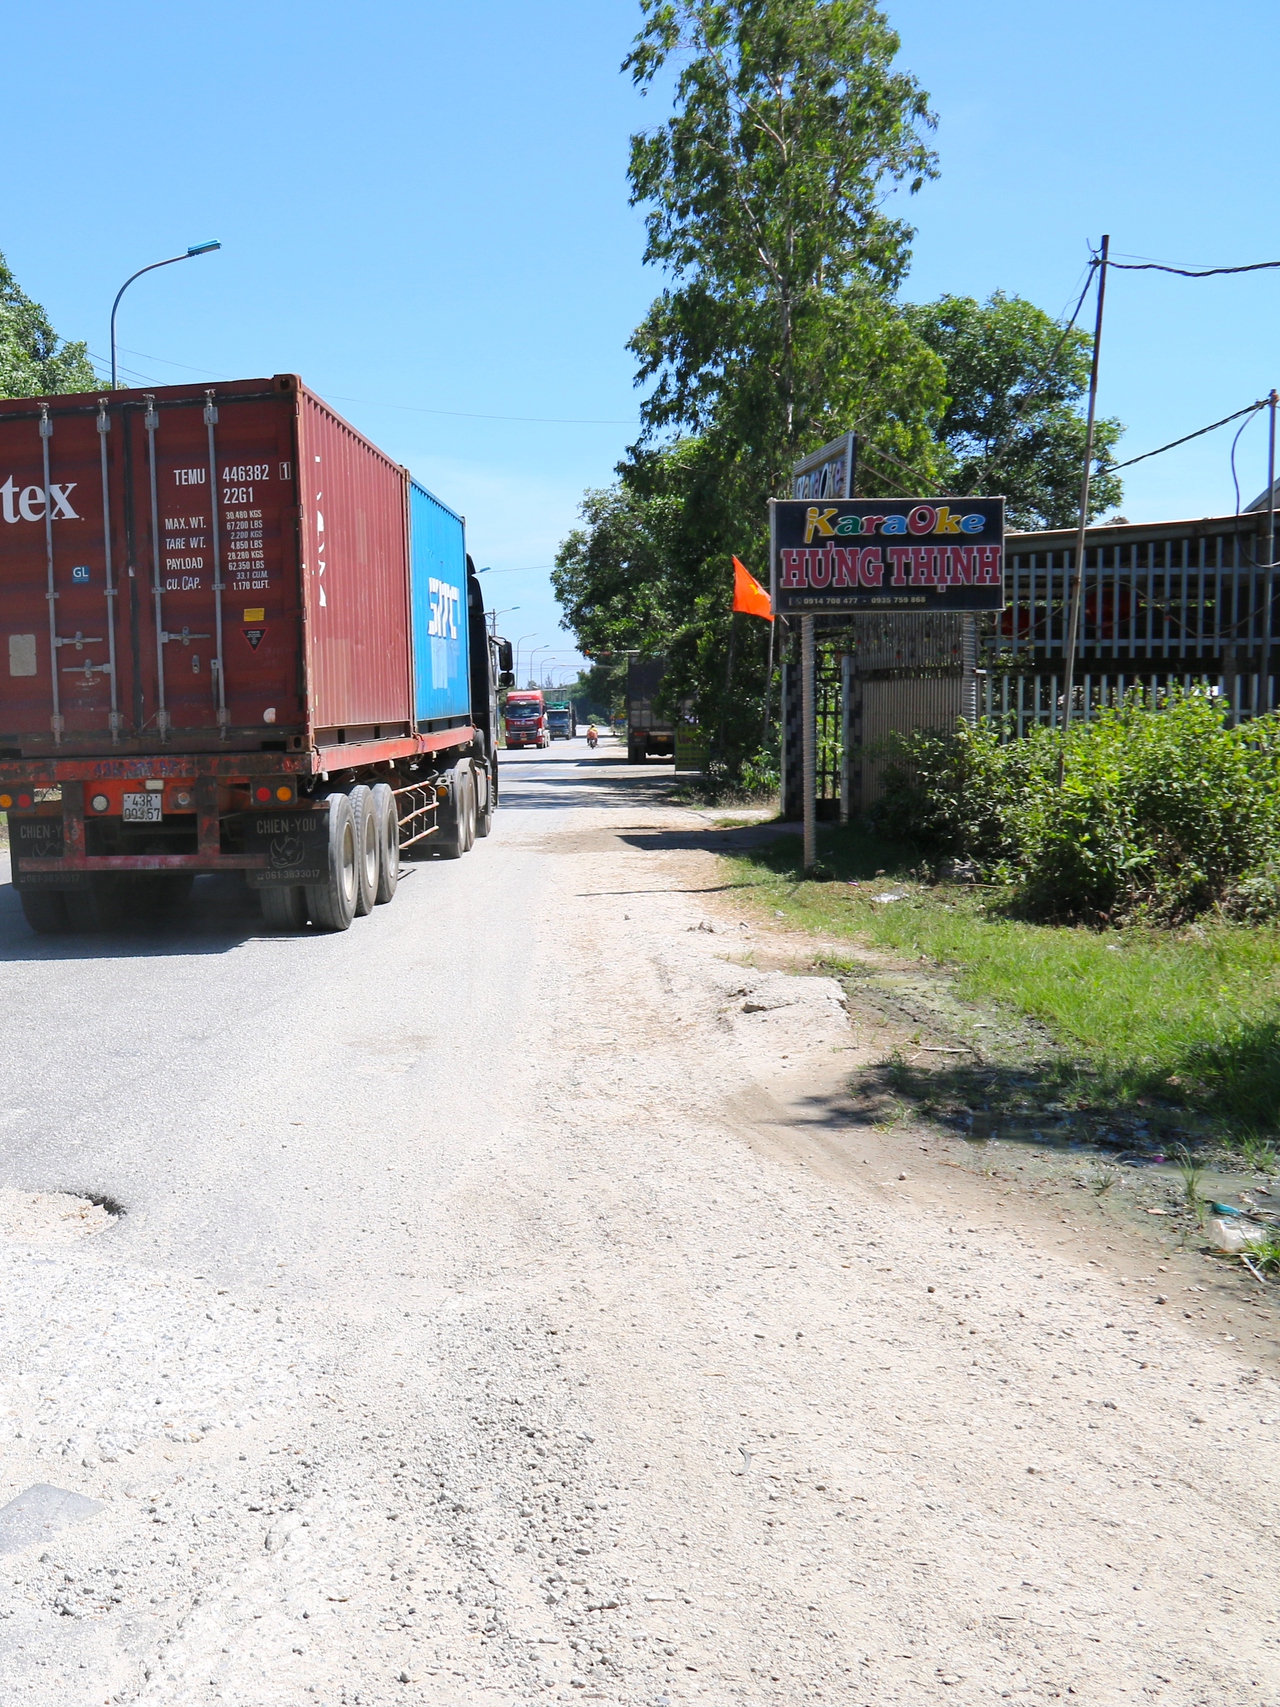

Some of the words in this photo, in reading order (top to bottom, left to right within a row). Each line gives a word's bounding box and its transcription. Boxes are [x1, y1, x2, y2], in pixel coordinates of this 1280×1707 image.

[174, 468, 206, 485] TEMU
[222, 464, 269, 482] 446382
[0, 474, 80, 524] tex
[223, 487, 254, 504] 22G1
[226, 511, 248, 520] 30.480
[249, 510, 262, 518] KGS
[165, 518, 188, 530] MAX.
[189, 517, 206, 529] WT.
[226, 521, 248, 530] 67.200
[250, 520, 263, 529] LBS
[804, 505, 986, 543] KaraOke
[231, 531, 248, 539] 2.200
[250, 530, 263, 538] KGS
[166, 537, 185, 550] TARE
[190, 537, 206, 548] WT.
[230, 541, 248, 550] 4.850
[250, 540, 263, 549] LBS
[227, 551, 249, 560] 28.280
[251, 550, 264, 558] KGS
[166, 557, 203, 570] PAYLOAD
[228, 561, 250, 571] 62.350
[252, 561, 264, 569] LBS
[780, 541, 884, 588] HƯNG
[887, 545, 1001, 592] THỊNH
[73, 567, 89, 578] GL
[236, 572, 250, 580] 33.1
[166, 579, 180, 590] CU.
[182, 576, 201, 590] CAP.
[233, 581, 250, 590] 1.170
[803, 597, 824, 605] 0914
[132, 795, 153, 807] 43R
